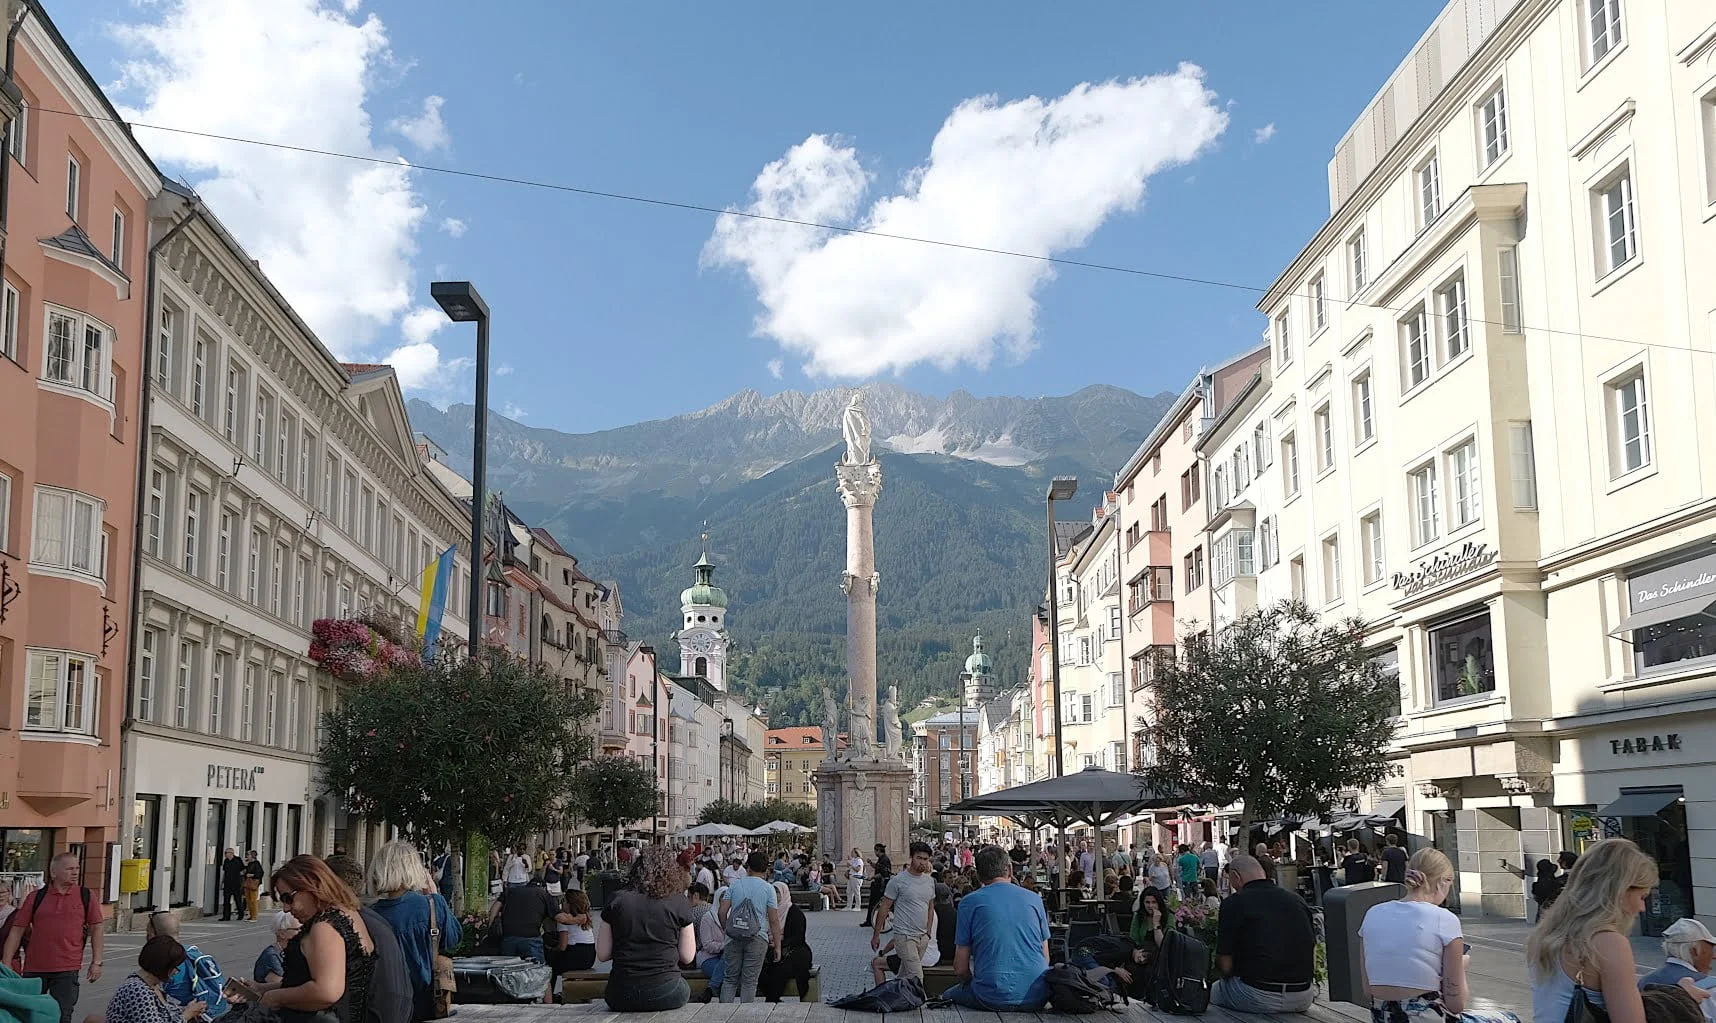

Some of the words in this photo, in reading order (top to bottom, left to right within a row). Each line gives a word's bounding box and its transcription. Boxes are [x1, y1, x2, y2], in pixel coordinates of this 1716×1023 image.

[1391, 571, 1415, 590] Das
[1416, 541, 1487, 581] Schindler
[1638, 590, 1658, 603] Das
[1660, 573, 1716, 597] Schindler
[1609, 733, 1682, 754] TABAK
[207, 764, 256, 791] PETERA
